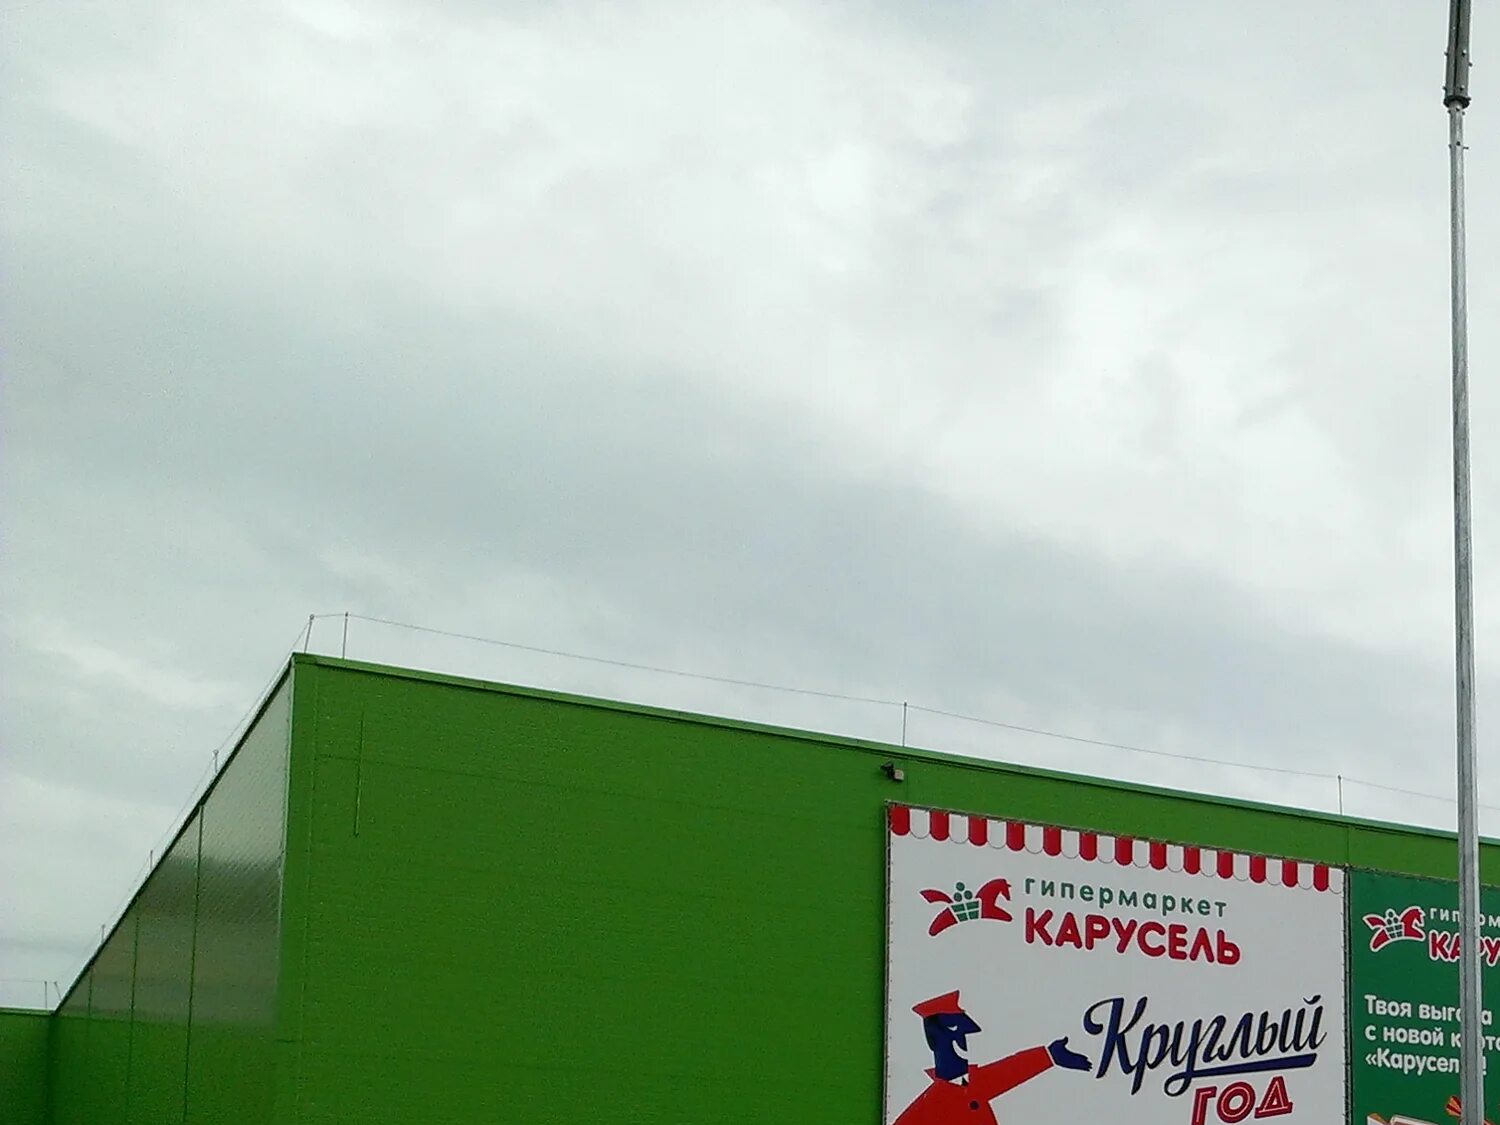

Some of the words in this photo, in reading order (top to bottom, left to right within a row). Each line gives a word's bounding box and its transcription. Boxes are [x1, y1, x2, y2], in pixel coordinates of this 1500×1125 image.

[1024, 876, 1228, 918] гипермаркет
[1025, 907, 1241, 966] КАРУСЕЛЬ
[1364, 994, 1412, 1018] Твоя
[1418, 1003, 1493, 1026] выга
[1083, 994, 1327, 1097] Круглый
[1364, 1025, 1377, 1041] с
[1382, 1026, 1444, 1047] новой
[1365, 1047, 1488, 1076] «Карусел!
